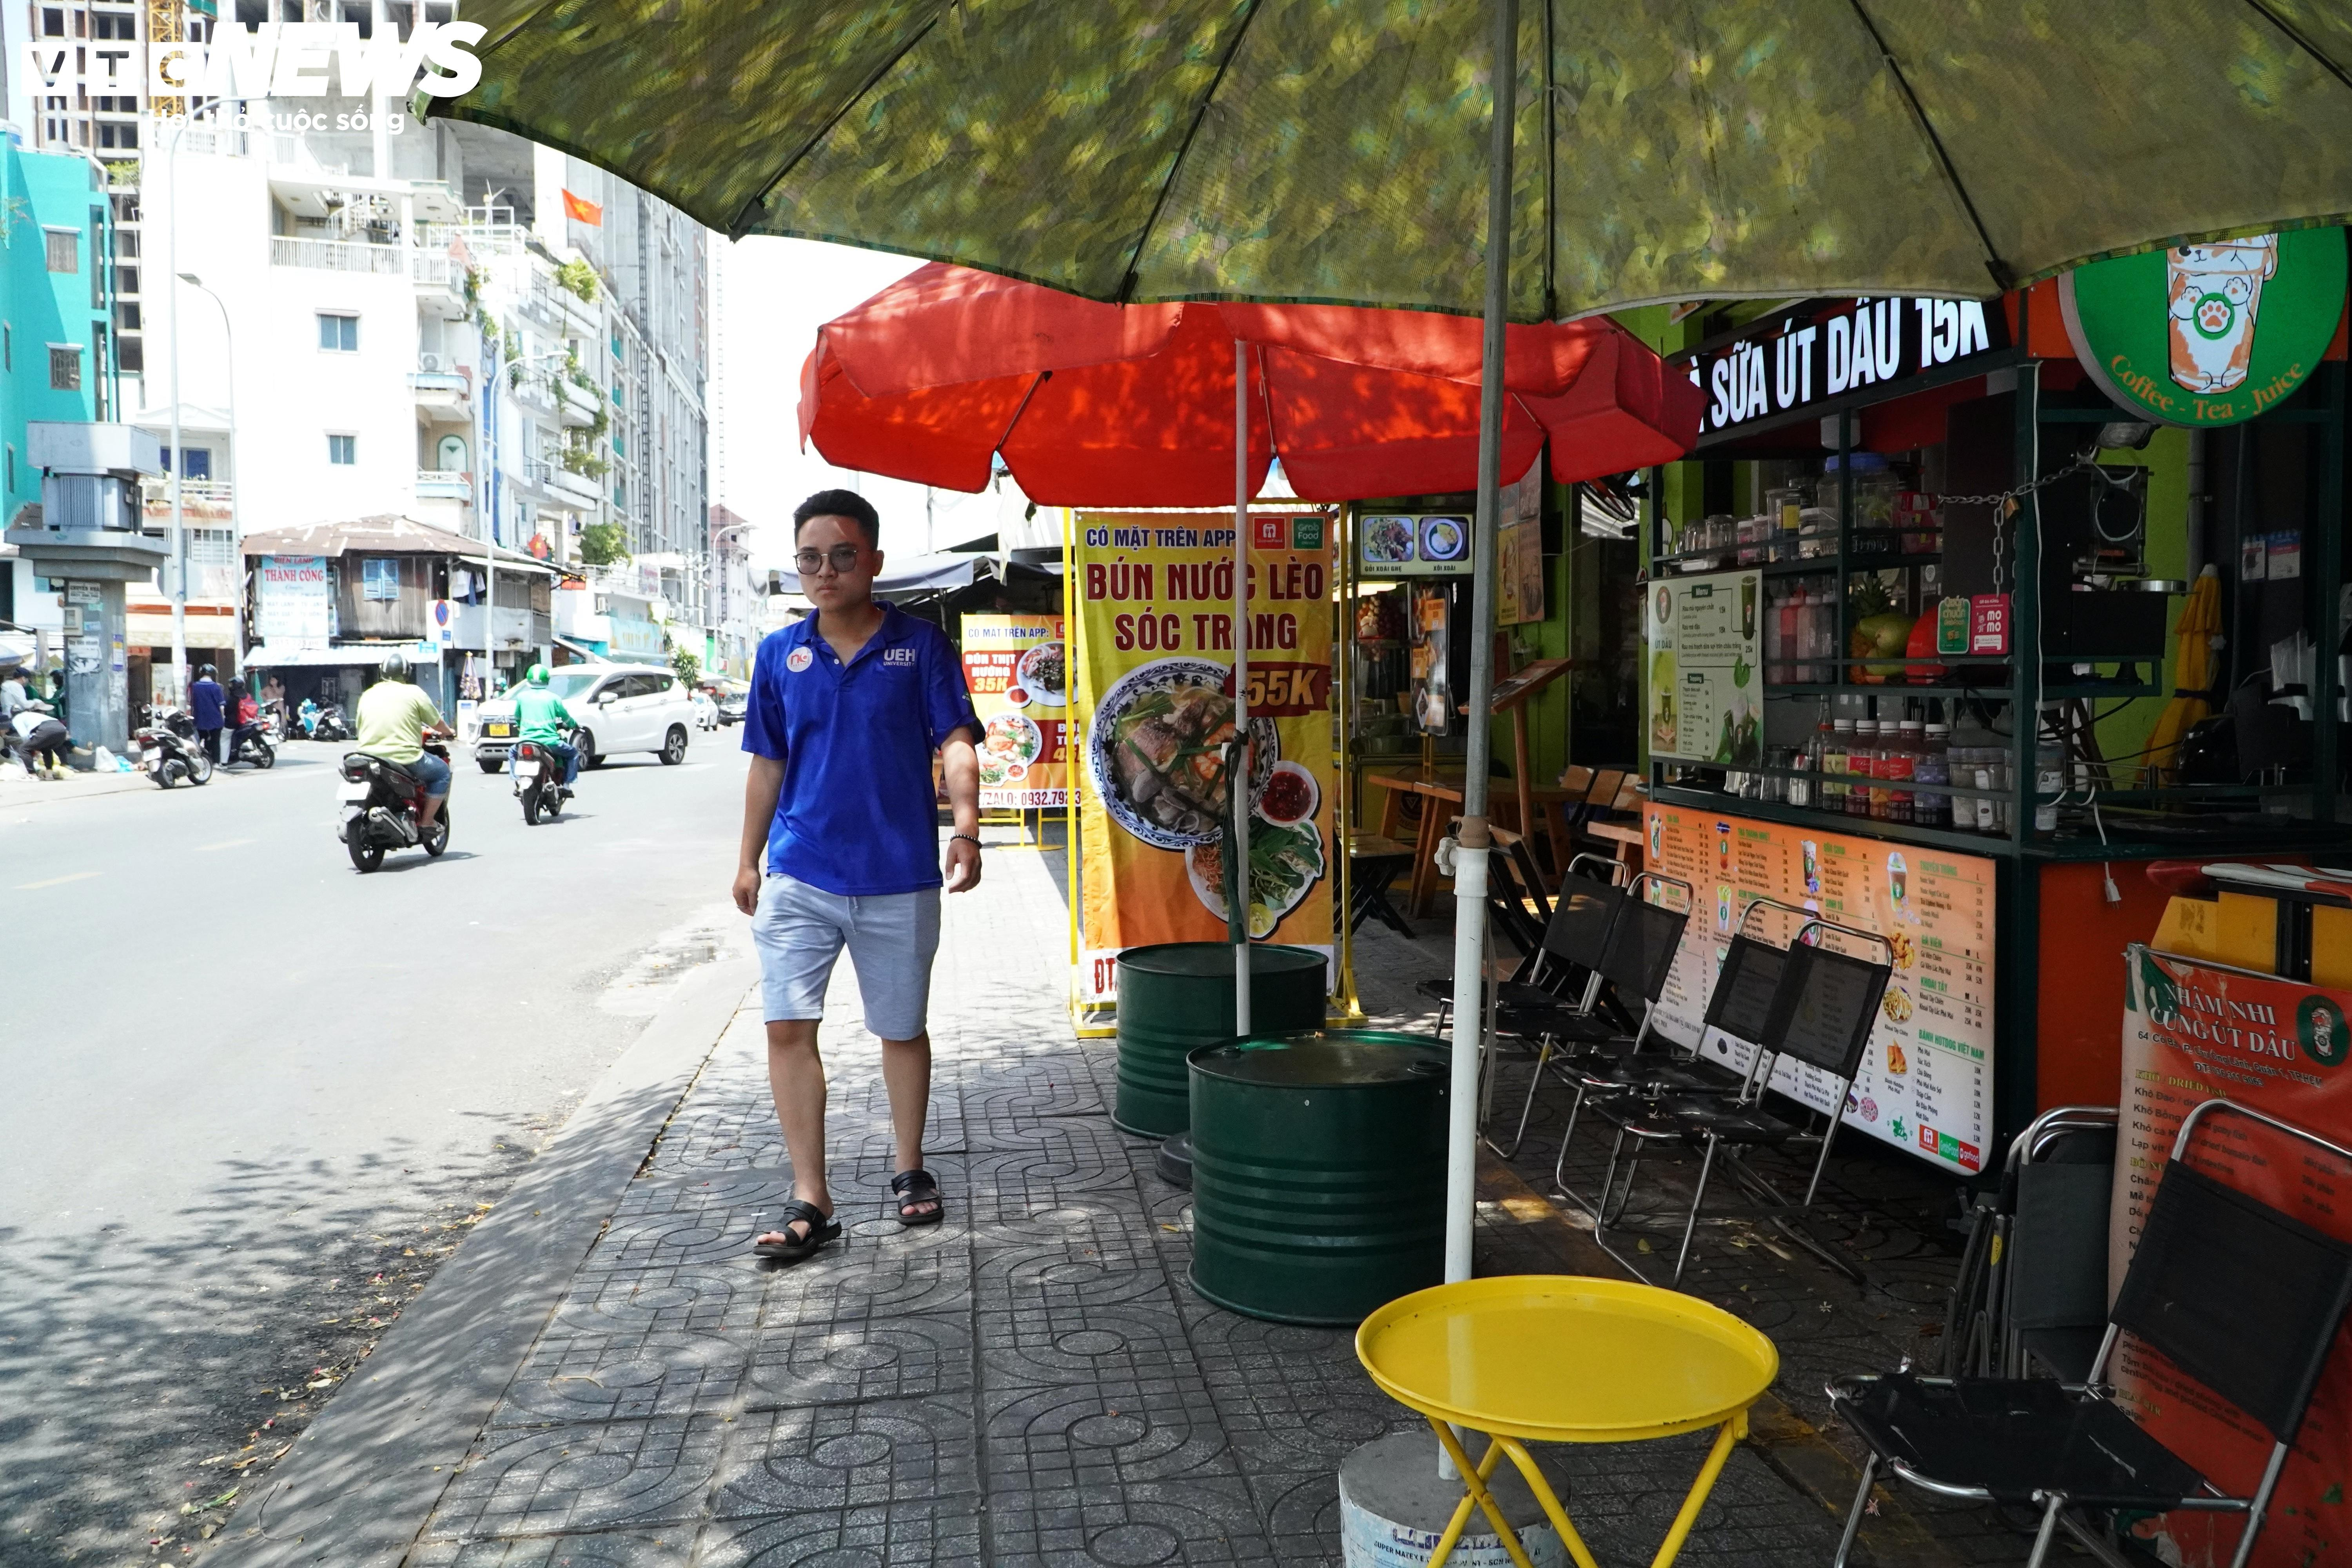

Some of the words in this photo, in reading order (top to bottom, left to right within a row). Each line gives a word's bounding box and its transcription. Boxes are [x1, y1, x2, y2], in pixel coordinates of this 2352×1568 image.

[1711, 339, 1768, 429] SỮA
[1776, 318, 1817, 409] ÚT
[1828, 297, 1901, 396] DÂU
[1915, 298, 1989, 368] 15K
[2111, 355, 2174, 412] Coffee
[2193, 399, 2234, 419] Tea
[2251, 363, 2305, 415] Juice
[1298, 522, 1319, 531] Grab
[1086, 525, 1109, 547] CÓ
[1114, 525, 1151, 550] MẶT
[1155, 526, 1198, 547] TRÊN
[1298, 532, 1319, 540] Food
[265, 566, 296, 582] THÀNH
[299, 566, 324, 582] CÔNG
[1086, 556, 1154, 601] BÚN
[1269, 555, 1324, 601] LÈO
[1005, 626, 1026, 637] TRÊN
[1029, 628, 1049, 637] APP:
[1114, 606, 1181, 652] SÓC
[1662, 637, 1672, 649] DÂU
[884, 648, 916, 662] UEH
[965, 653, 989, 665] BÚN
[993, 654, 1016, 666] THỊT
[974, 678, 1008, 692] 35K
[1247, 668, 1318, 707] 55K
[2163, 983, 2224, 1016] NHÂM
[2229, 1001, 2277, 1025] NHI
[2149, 1004, 2207, 1040] CÙNG
[2212, 1021, 2241, 1048] ÚT
[2249, 1029, 2296, 1061] DÂU
[1919, 1029, 1934, 1044] BÁNH
[1935, 1033, 1956, 1051] HOTDOG
[1958, 1041, 1970, 1056] VIỆT
[1971, 1047, 1985, 1061] NAM
[2138, 1031, 2149, 1040] 64
[2254, 1062, 2278, 1077] Quận
[2169, 1076, 2204, 1091] DRIED
[2135, 1087, 2154, 1097] Khô
[2134, 1103, 2153, 1115] Khô
[2132, 1121, 2152, 1132] Khô
[2132, 1138, 2149, 1150] Lạp
[2151, 1143, 2164, 1153] vịt
[1964, 1149, 1979, 1163] gofood
[2122, 1353, 2140, 1367] Tôm
[1374, 1541, 1394, 1554] SUPER
